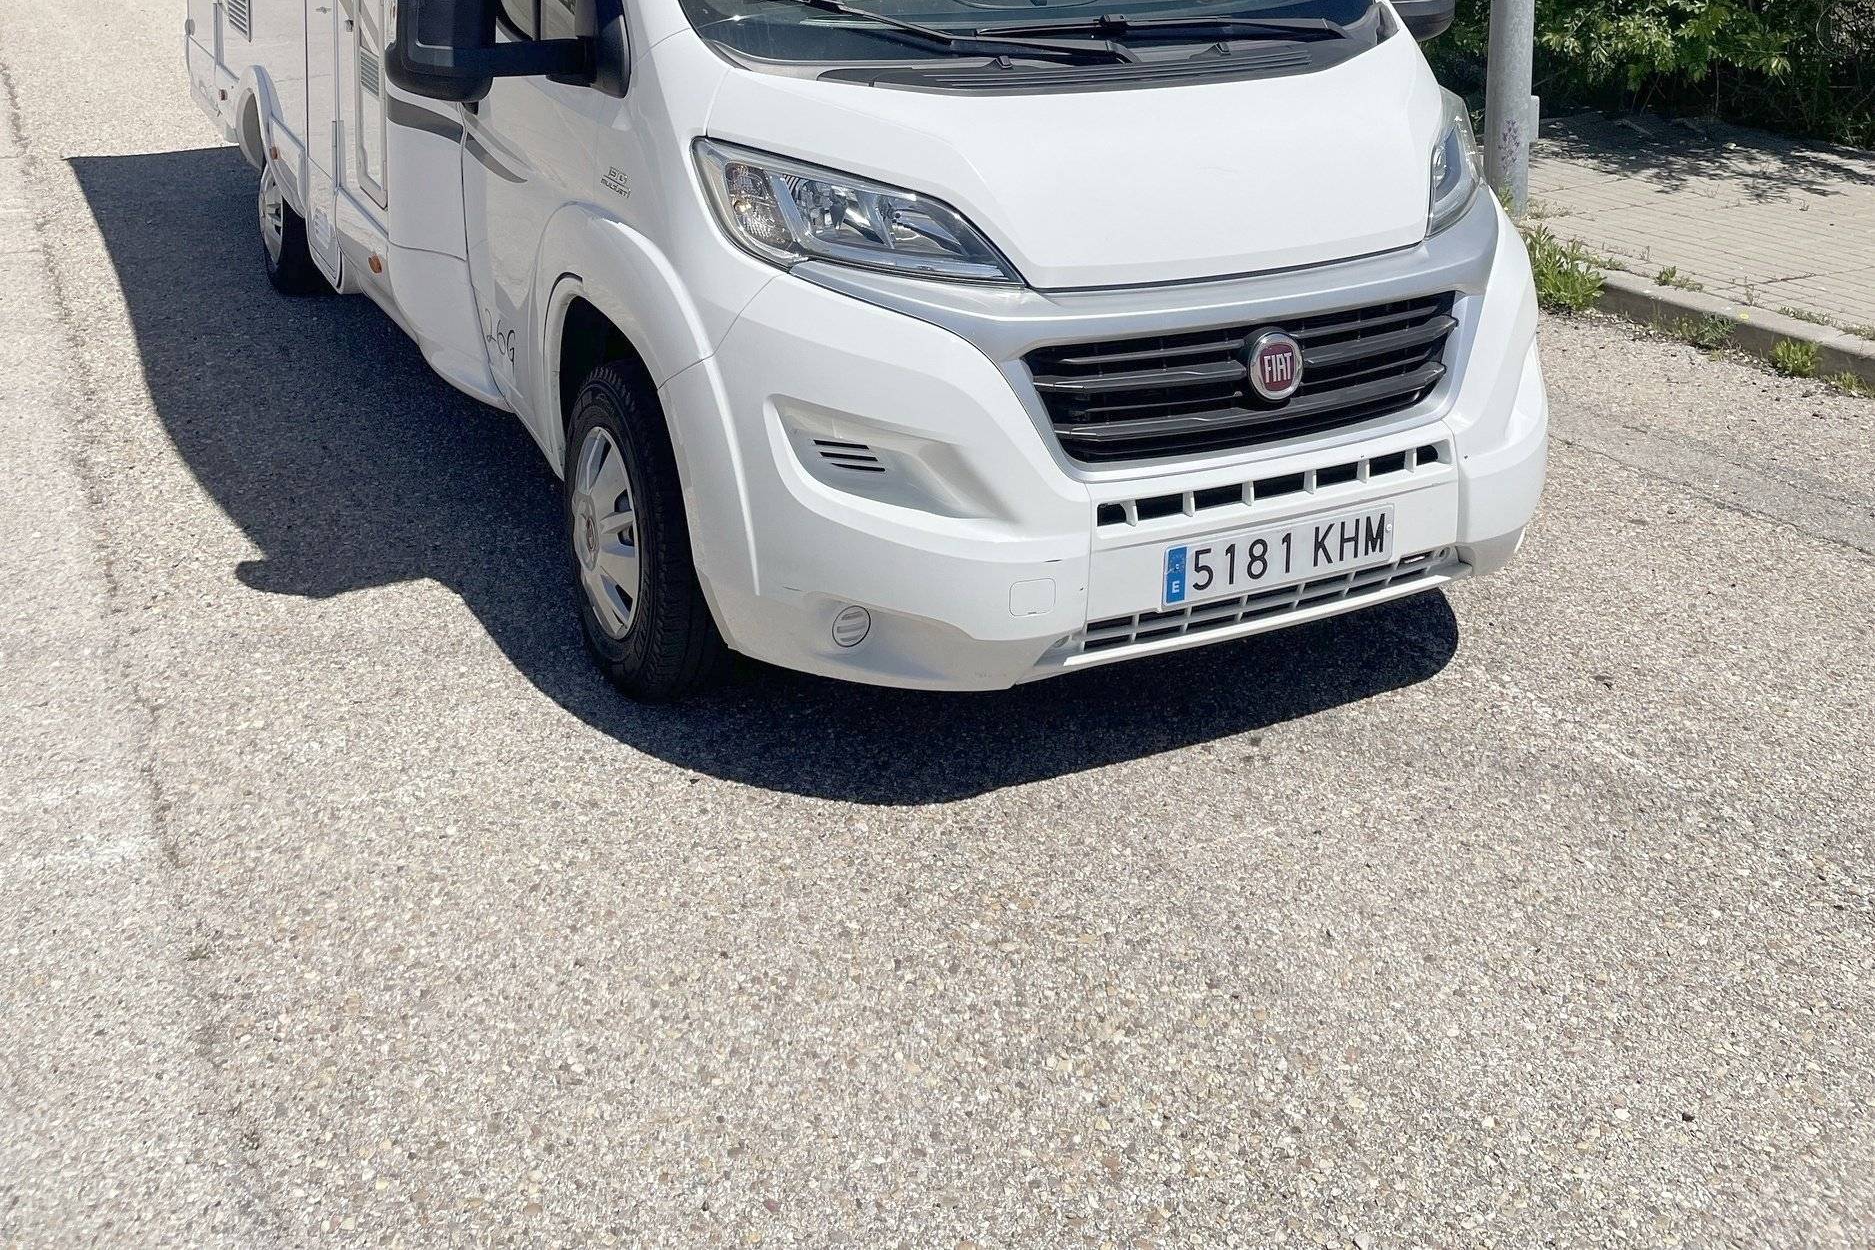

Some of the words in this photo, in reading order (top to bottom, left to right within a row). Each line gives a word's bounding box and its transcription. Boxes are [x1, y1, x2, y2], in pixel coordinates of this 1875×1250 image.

[1263, 351, 1292, 384] FIAT
[1192, 532, 1292, 591] 5181
[1313, 513, 1386, 567] KHM
[1171, 580, 1180, 594] E
